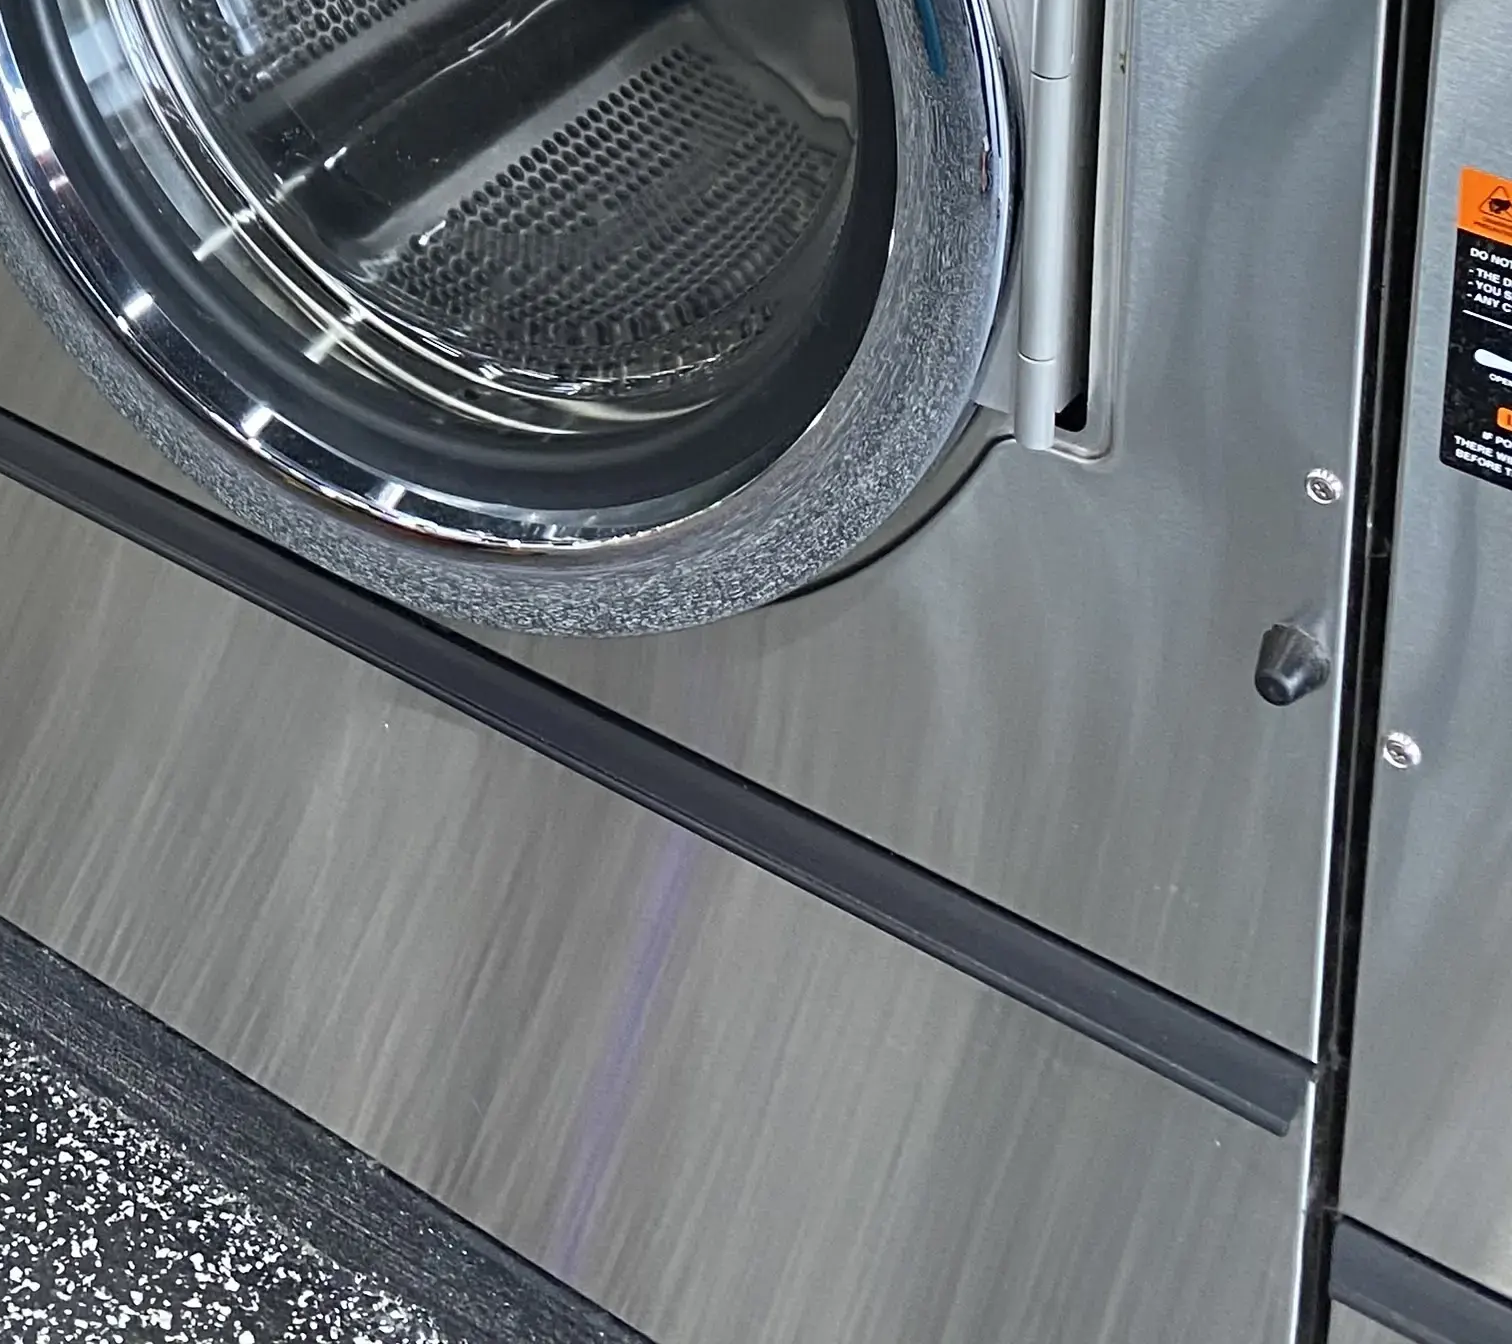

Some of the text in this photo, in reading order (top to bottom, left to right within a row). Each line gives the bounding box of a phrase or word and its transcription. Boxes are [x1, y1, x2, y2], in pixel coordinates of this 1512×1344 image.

[1470, 247, 1488, 261] DO
[1476, 268, 1500, 284] THE
[1475, 280, 1501, 296] YOU
[1474, 293, 1500, 308] ANY
[1454, 435, 1493, 457] THERE
[1455, 448, 1502, 473] BEFORE
